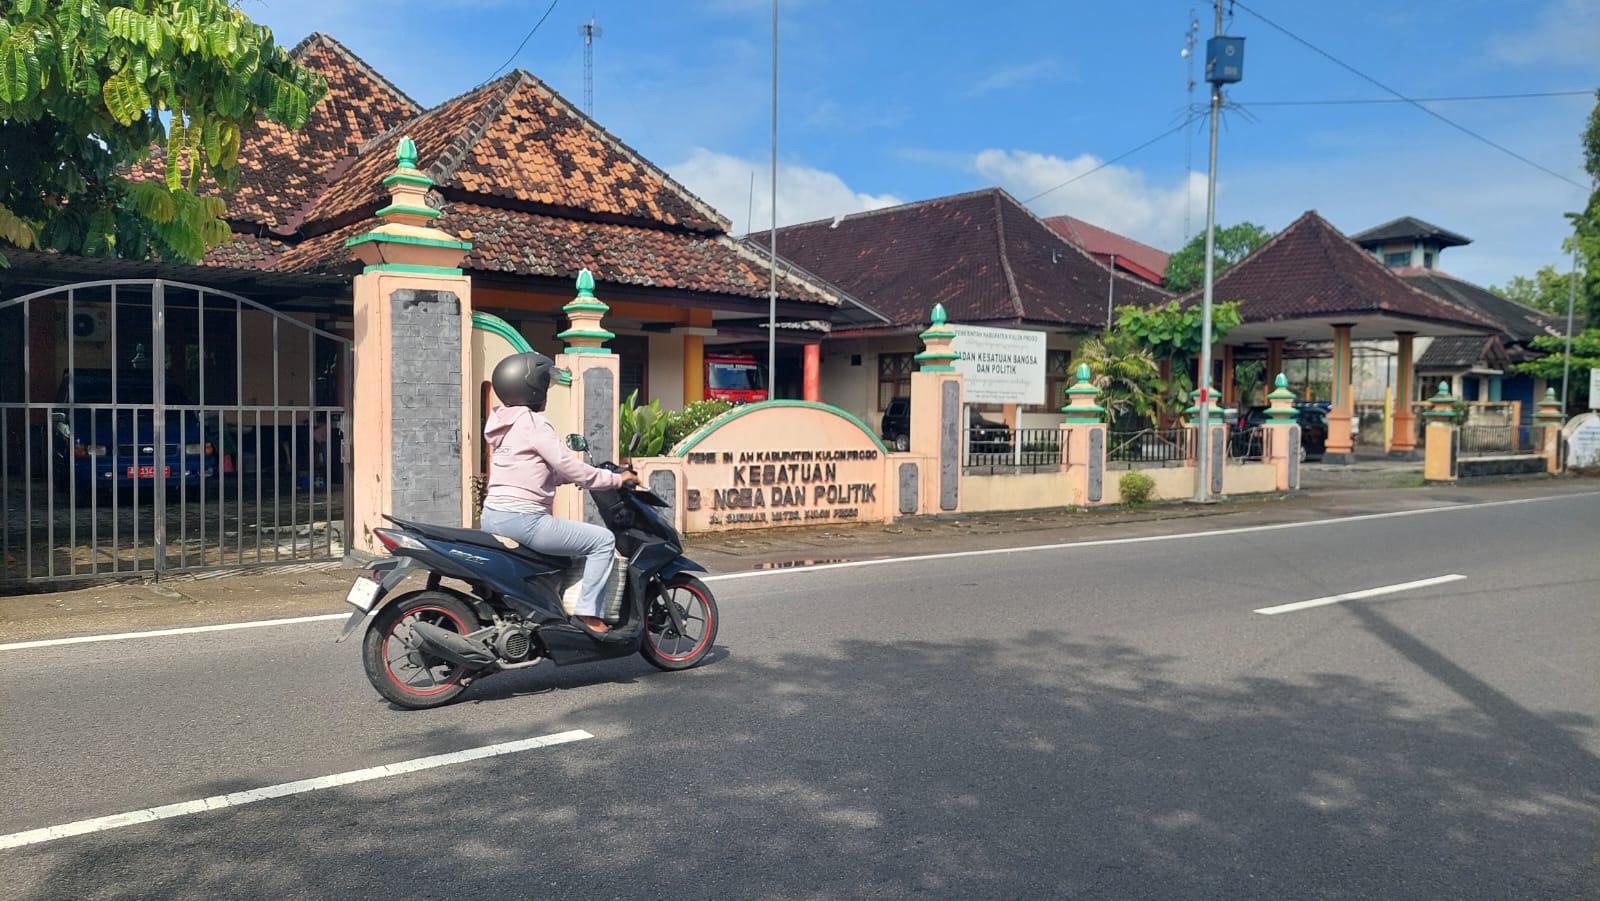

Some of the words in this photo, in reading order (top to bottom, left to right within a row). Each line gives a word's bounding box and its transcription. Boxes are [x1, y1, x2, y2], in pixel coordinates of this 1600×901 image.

[978, 352, 1011, 363] KESATUAN
[1013, 354, 1038, 365] BANGSA
[977, 363, 990, 373] DAN
[992, 364, 1016, 375] POLITIK
[756, 450, 813, 462] KABUPATEN
[815, 450, 846, 461] KULON
[847, 450, 878, 461] PROGO
[733, 463, 836, 486] KESATUAN
[687, 487, 765, 511] BNGSA
[771, 486, 806, 507] DAN
[814, 484, 876, 506] POLITIK
